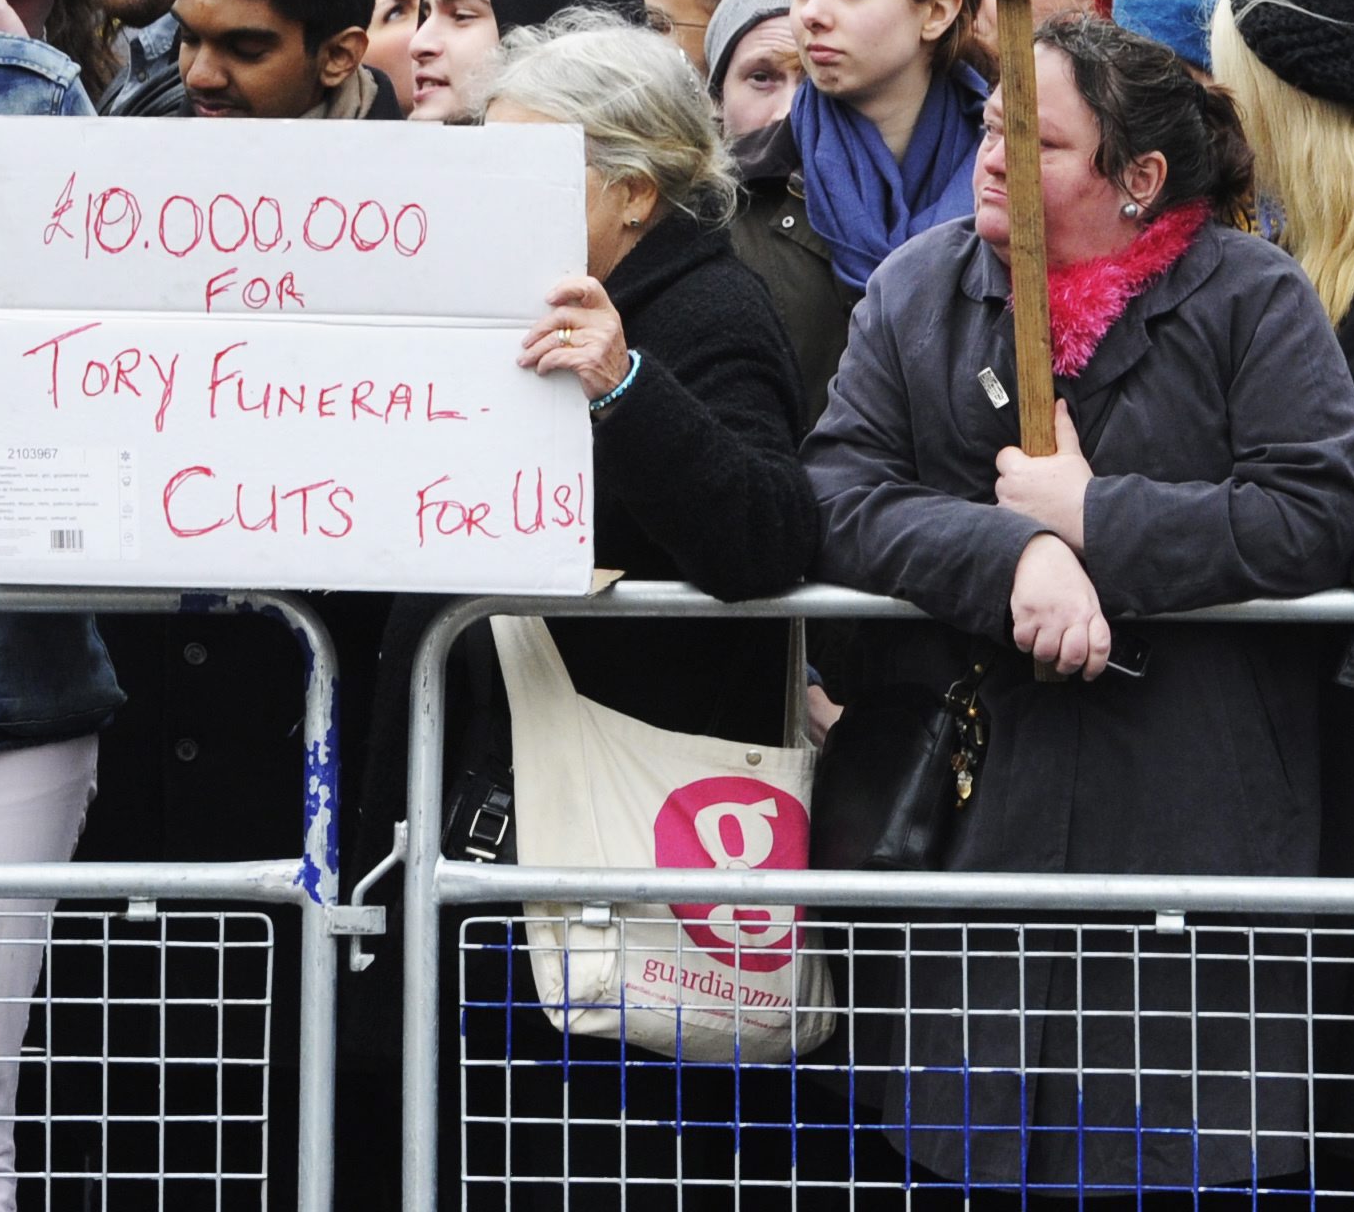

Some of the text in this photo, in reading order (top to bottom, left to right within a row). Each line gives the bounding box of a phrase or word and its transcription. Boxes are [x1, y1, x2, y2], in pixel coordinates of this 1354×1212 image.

[206, 267, 305, 313] FOR
[24, 322, 179, 432] TORY
[7, 447, 59, 460] 2103967
[162, 466, 354, 537] CUTS
[417, 474, 500, 547] FOR
[512, 467, 586, 543] US!
